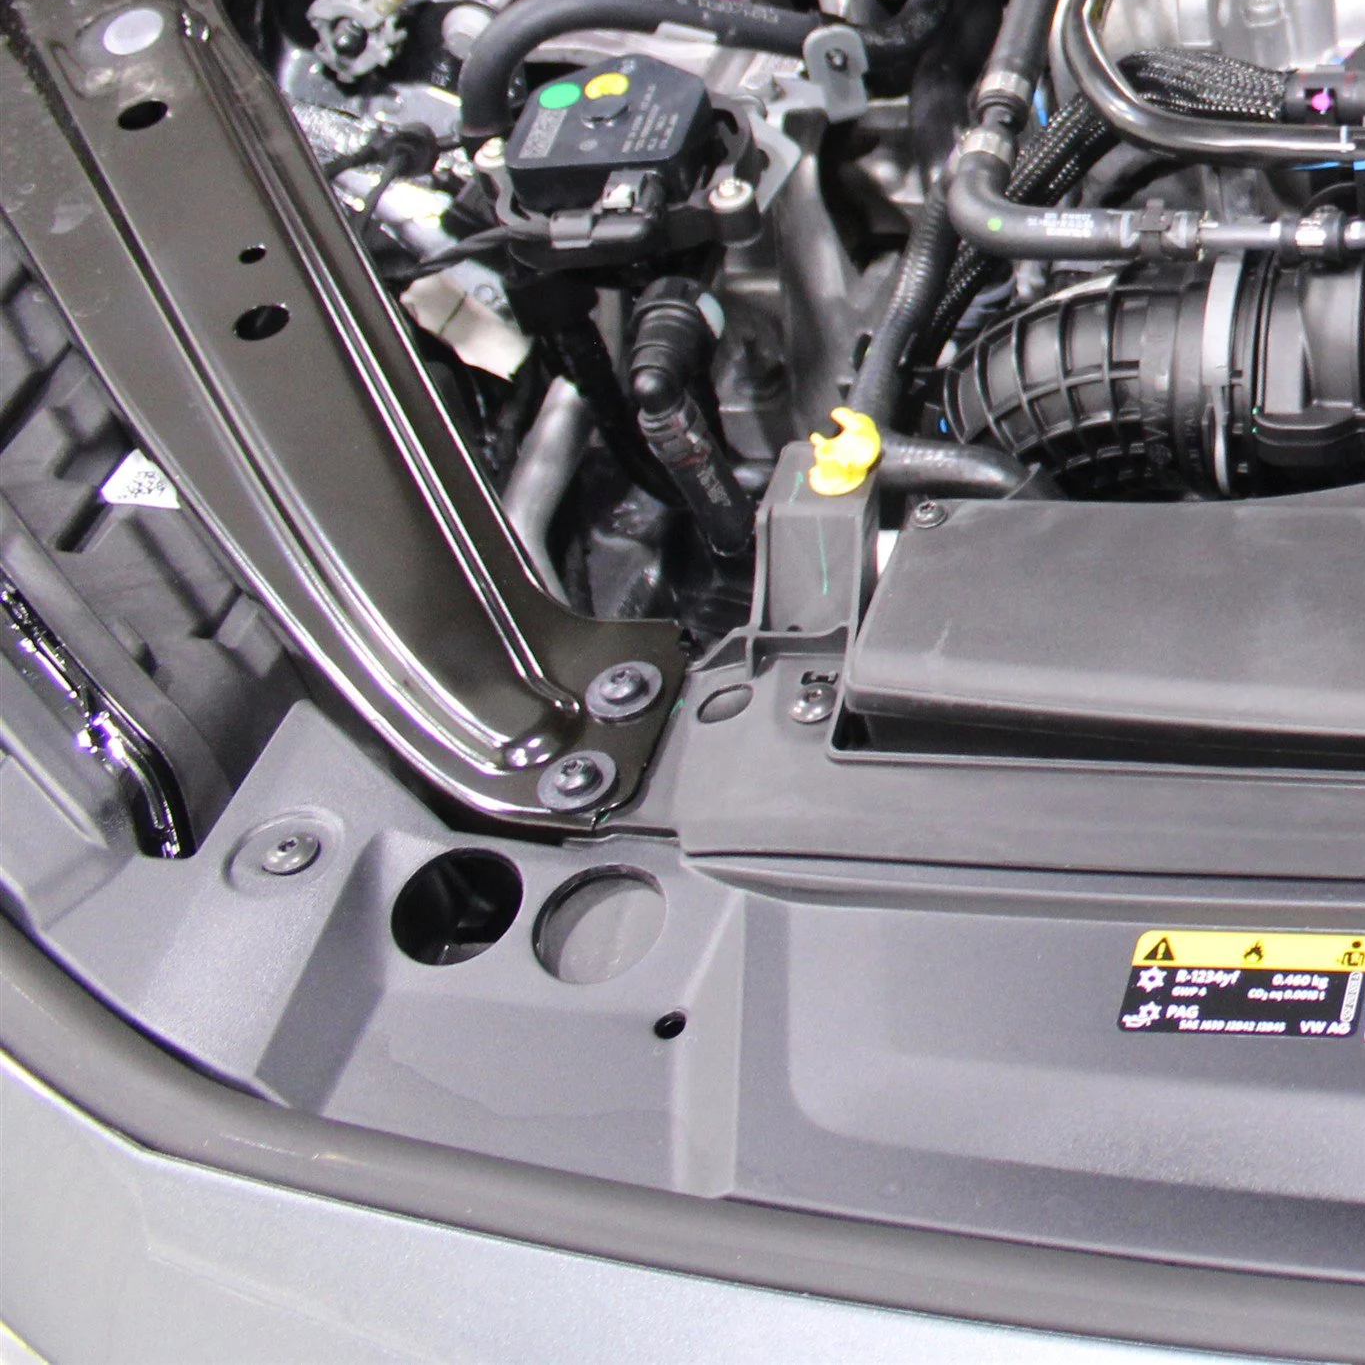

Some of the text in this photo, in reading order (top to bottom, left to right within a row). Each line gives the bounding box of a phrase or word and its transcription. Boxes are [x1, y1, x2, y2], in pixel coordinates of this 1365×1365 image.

[1173, 969, 1240, 988] R-1234yf
[1270, 974, 1329, 989] 0.460 kg
[1164, 1005, 1200, 1019] PAG
[1298, 1020, 1351, 1035] VW AG
